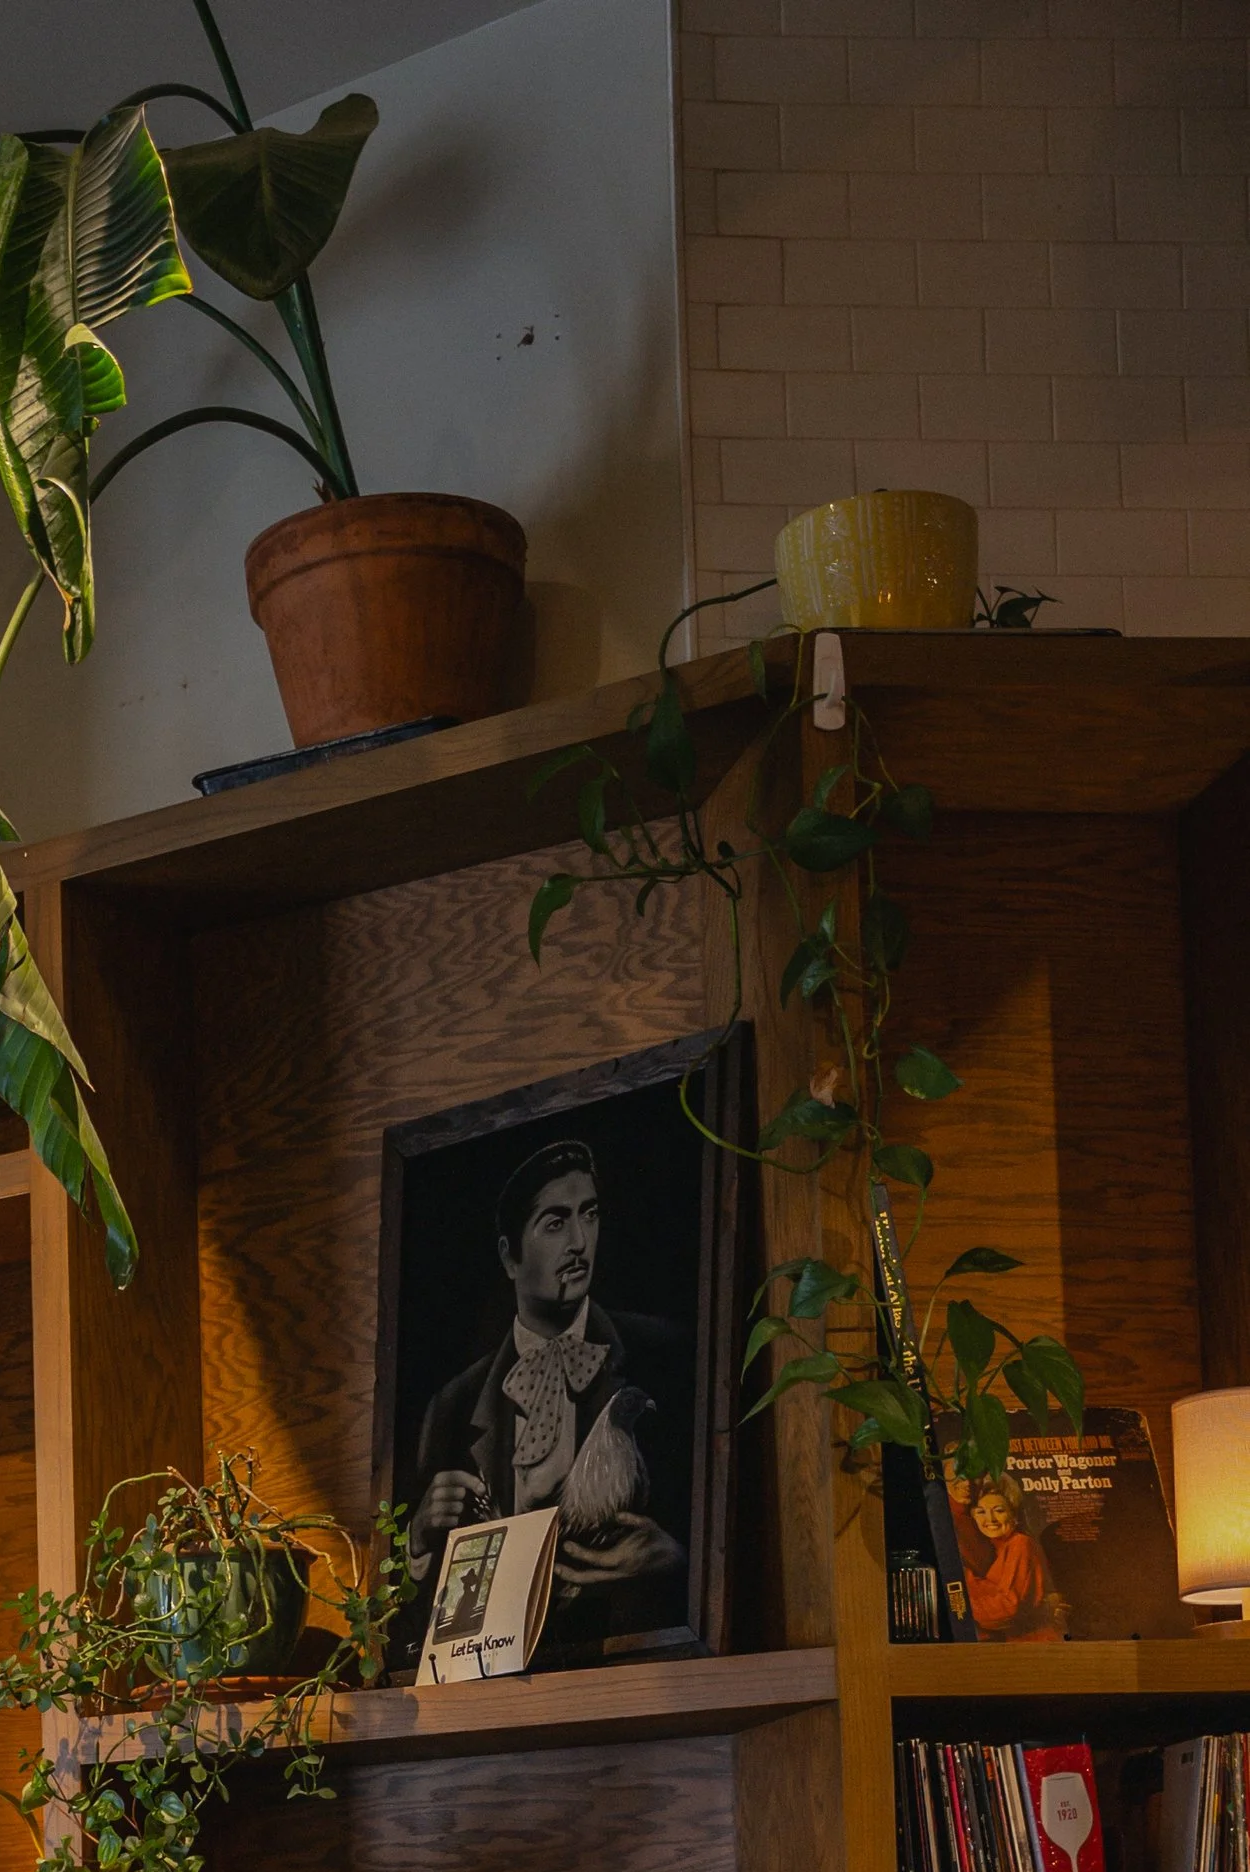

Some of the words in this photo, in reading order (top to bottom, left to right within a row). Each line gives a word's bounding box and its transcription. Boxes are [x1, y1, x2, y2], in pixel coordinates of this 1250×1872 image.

[875, 1211, 900, 1287] Historial
[902, 1349, 917, 1376] the
[1022, 1436, 1062, 1452] BETWEEN
[1006, 1456, 1053, 1470] Porter
[1052, 1454, 1117, 1470] Wagoner
[1057, 1468, 1072, 1476] and
[1021, 1476, 1060, 1493] Dolly
[1060, 1475, 1113, 1490] Parton
[451, 1642, 467, 1658] Let
[484, 1635, 515, 1651] Know
[1057, 1808, 1078, 1821] 1920
